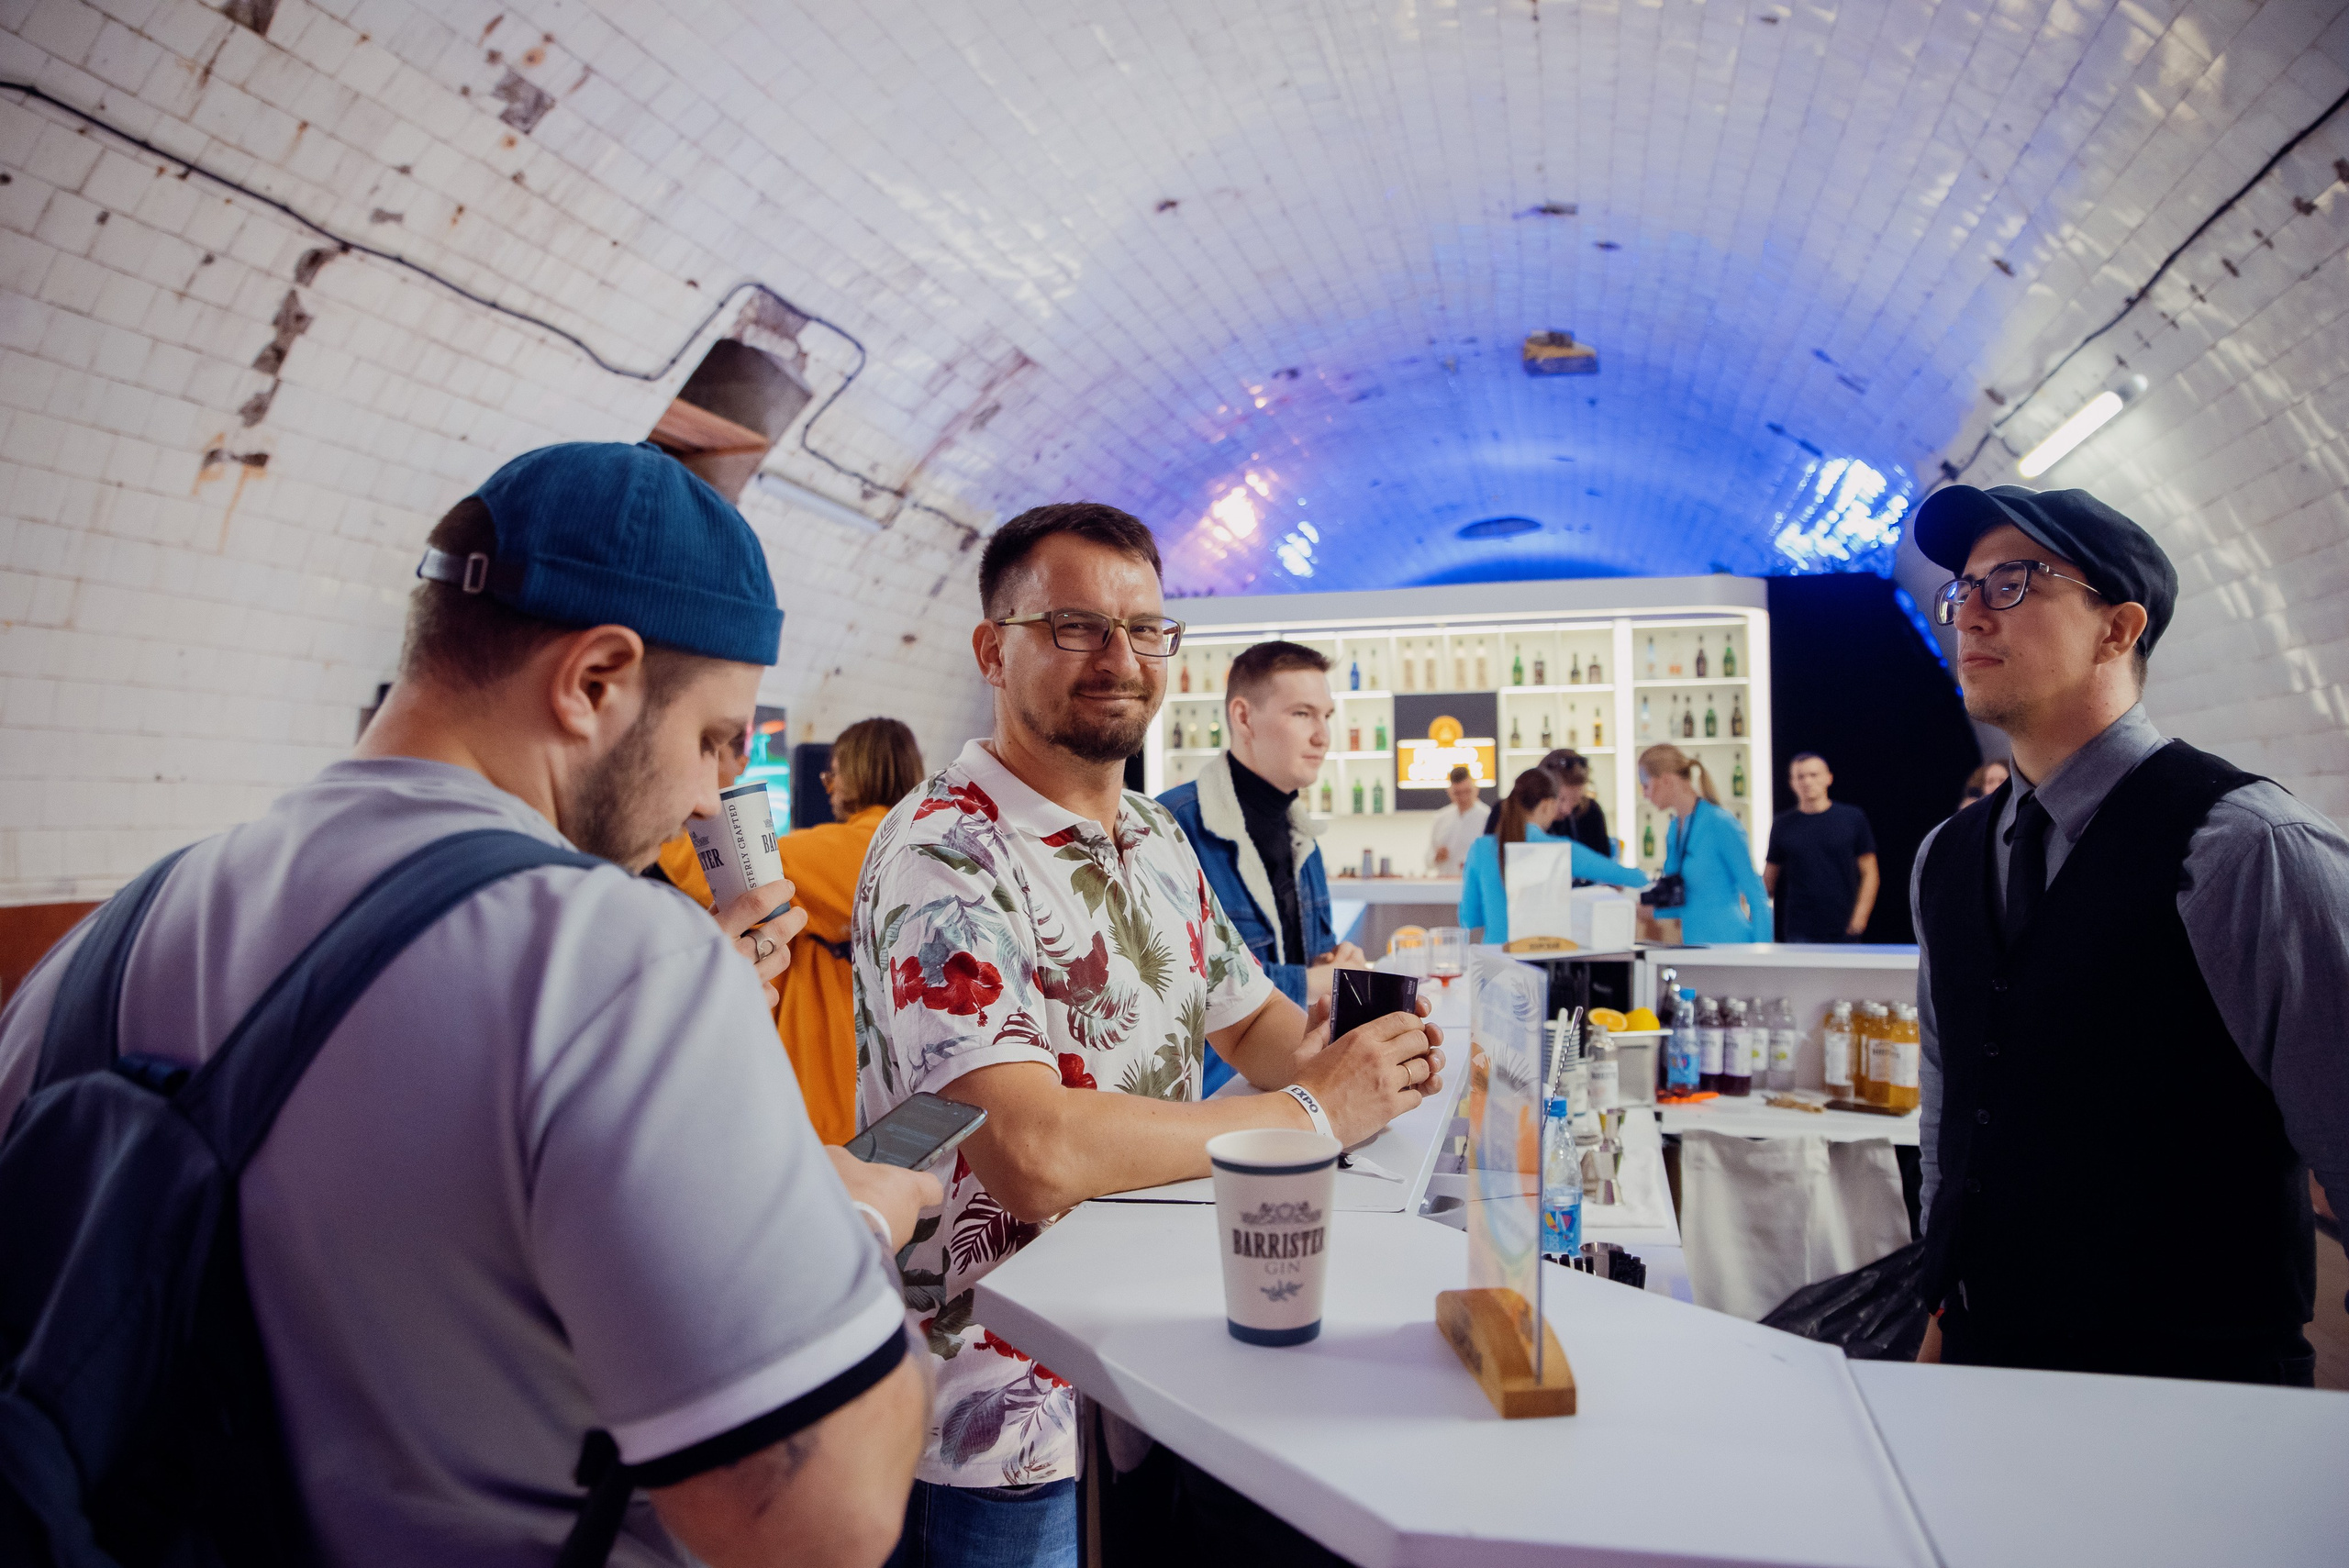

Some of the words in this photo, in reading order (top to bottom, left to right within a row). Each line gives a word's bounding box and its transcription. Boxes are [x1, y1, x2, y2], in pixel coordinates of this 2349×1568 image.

[729, 805, 746, 850] CRAFTED
[1290, 1087, 1319, 1113] EXPO
[1264, 1262, 1300, 1275] GIN
